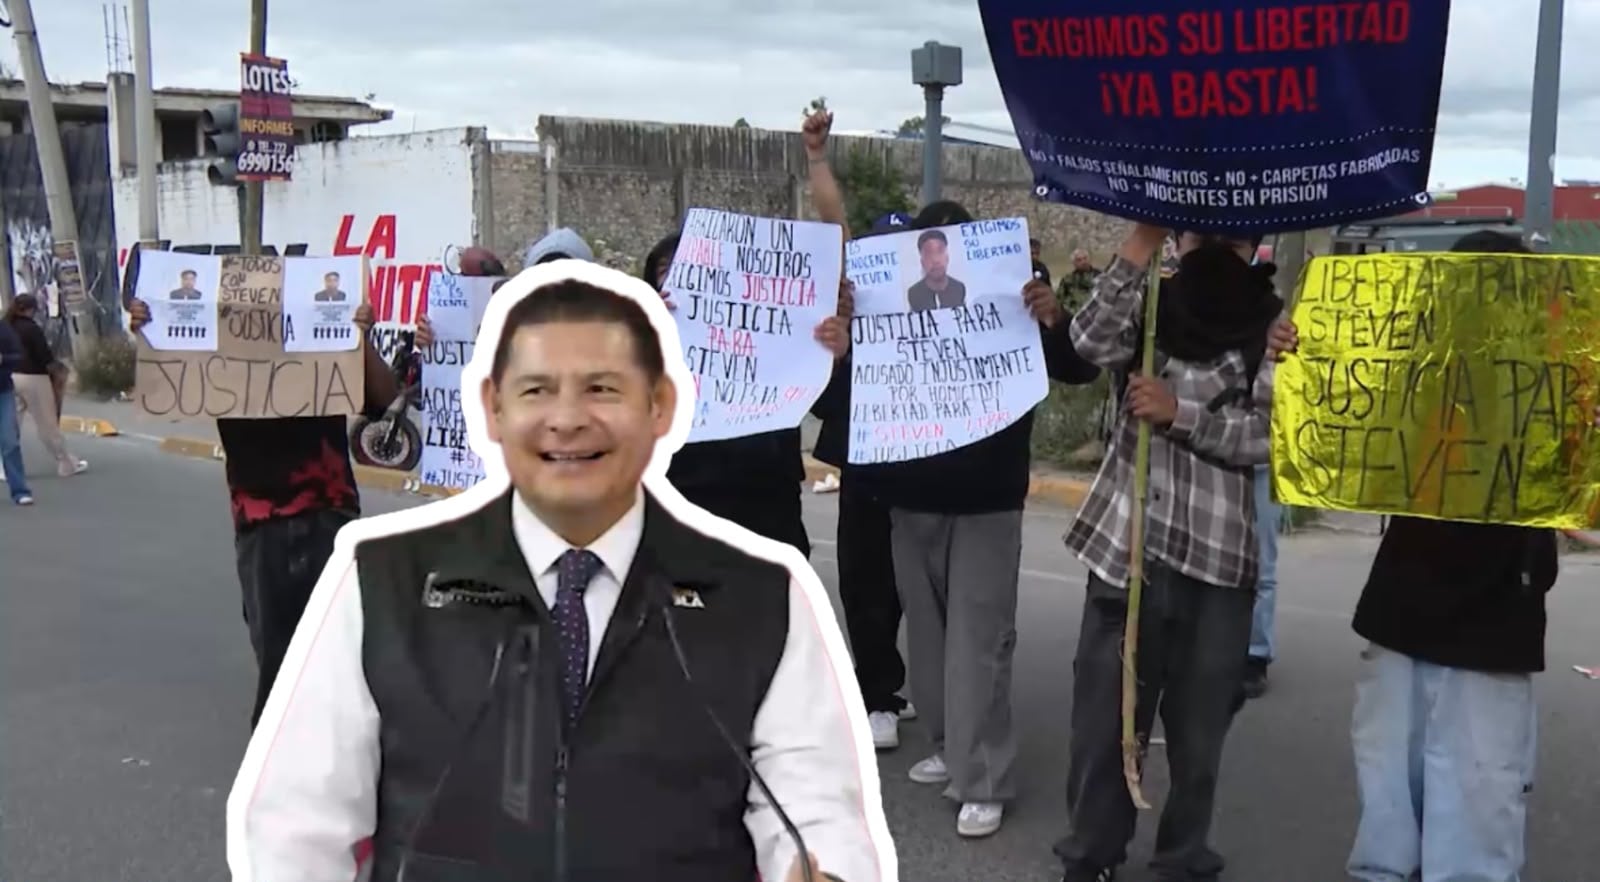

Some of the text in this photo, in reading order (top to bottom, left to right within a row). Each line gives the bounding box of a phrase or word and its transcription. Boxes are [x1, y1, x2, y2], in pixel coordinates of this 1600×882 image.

[1012, 1, 1410, 58] EXIGIMOS SU LIBERTAD
[242, 63, 289, 95] LOTES
[1099, 66, 1318, 118] ¡YA BASTA!
[240, 118, 294, 135] INFORMES
[238, 152, 293, 173] 6990156
[1057, 154, 1101, 173] FALSOS
[1102, 160, 1208, 186] SEÑALAMIENTOS
[1226, 170, 1246, 186] NO
[1262, 163, 1337, 185] CARPETAS
[1341, 148, 1420, 177] FABRICADAS
[1108, 177, 1128, 193] NO
[1145, 182, 1228, 207] INOCENTES
[1233, 189, 1255, 206] EN
[1260, 179, 1328, 206] PRISIÓN
[334, 215, 396, 259] LA
[769, 220, 794, 252] UN
[960, 219, 1021, 237] EXIGIMOS
[736, 246, 812, 280] NOSOTROS
[966, 245, 1022, 261] LIBERTAD
[222, 286, 281, 304] STEVEN
[670, 262, 817, 306] XIGIMOS JUSTICIA
[851, 270, 893, 286] TEVEN
[221, 305, 296, 344] #JUSTICIA
[687, 294, 793, 336] JUSTICIA
[854, 301, 1004, 345] JUSTICIA PARA
[1308, 306, 1435, 350] STEVEN
[708, 325, 757, 357] PARA
[896, 337, 967, 364] STEVEN
[687, 345, 757, 383] STEVEN
[854, 363, 915, 385] ACUSADO
[138, 355, 357, 418] JUSTICIA
[1302, 354, 1478, 432] JUSTICIA
[934, 399, 971, 419] PARA
[1296, 418, 1525, 516] STEVEN
